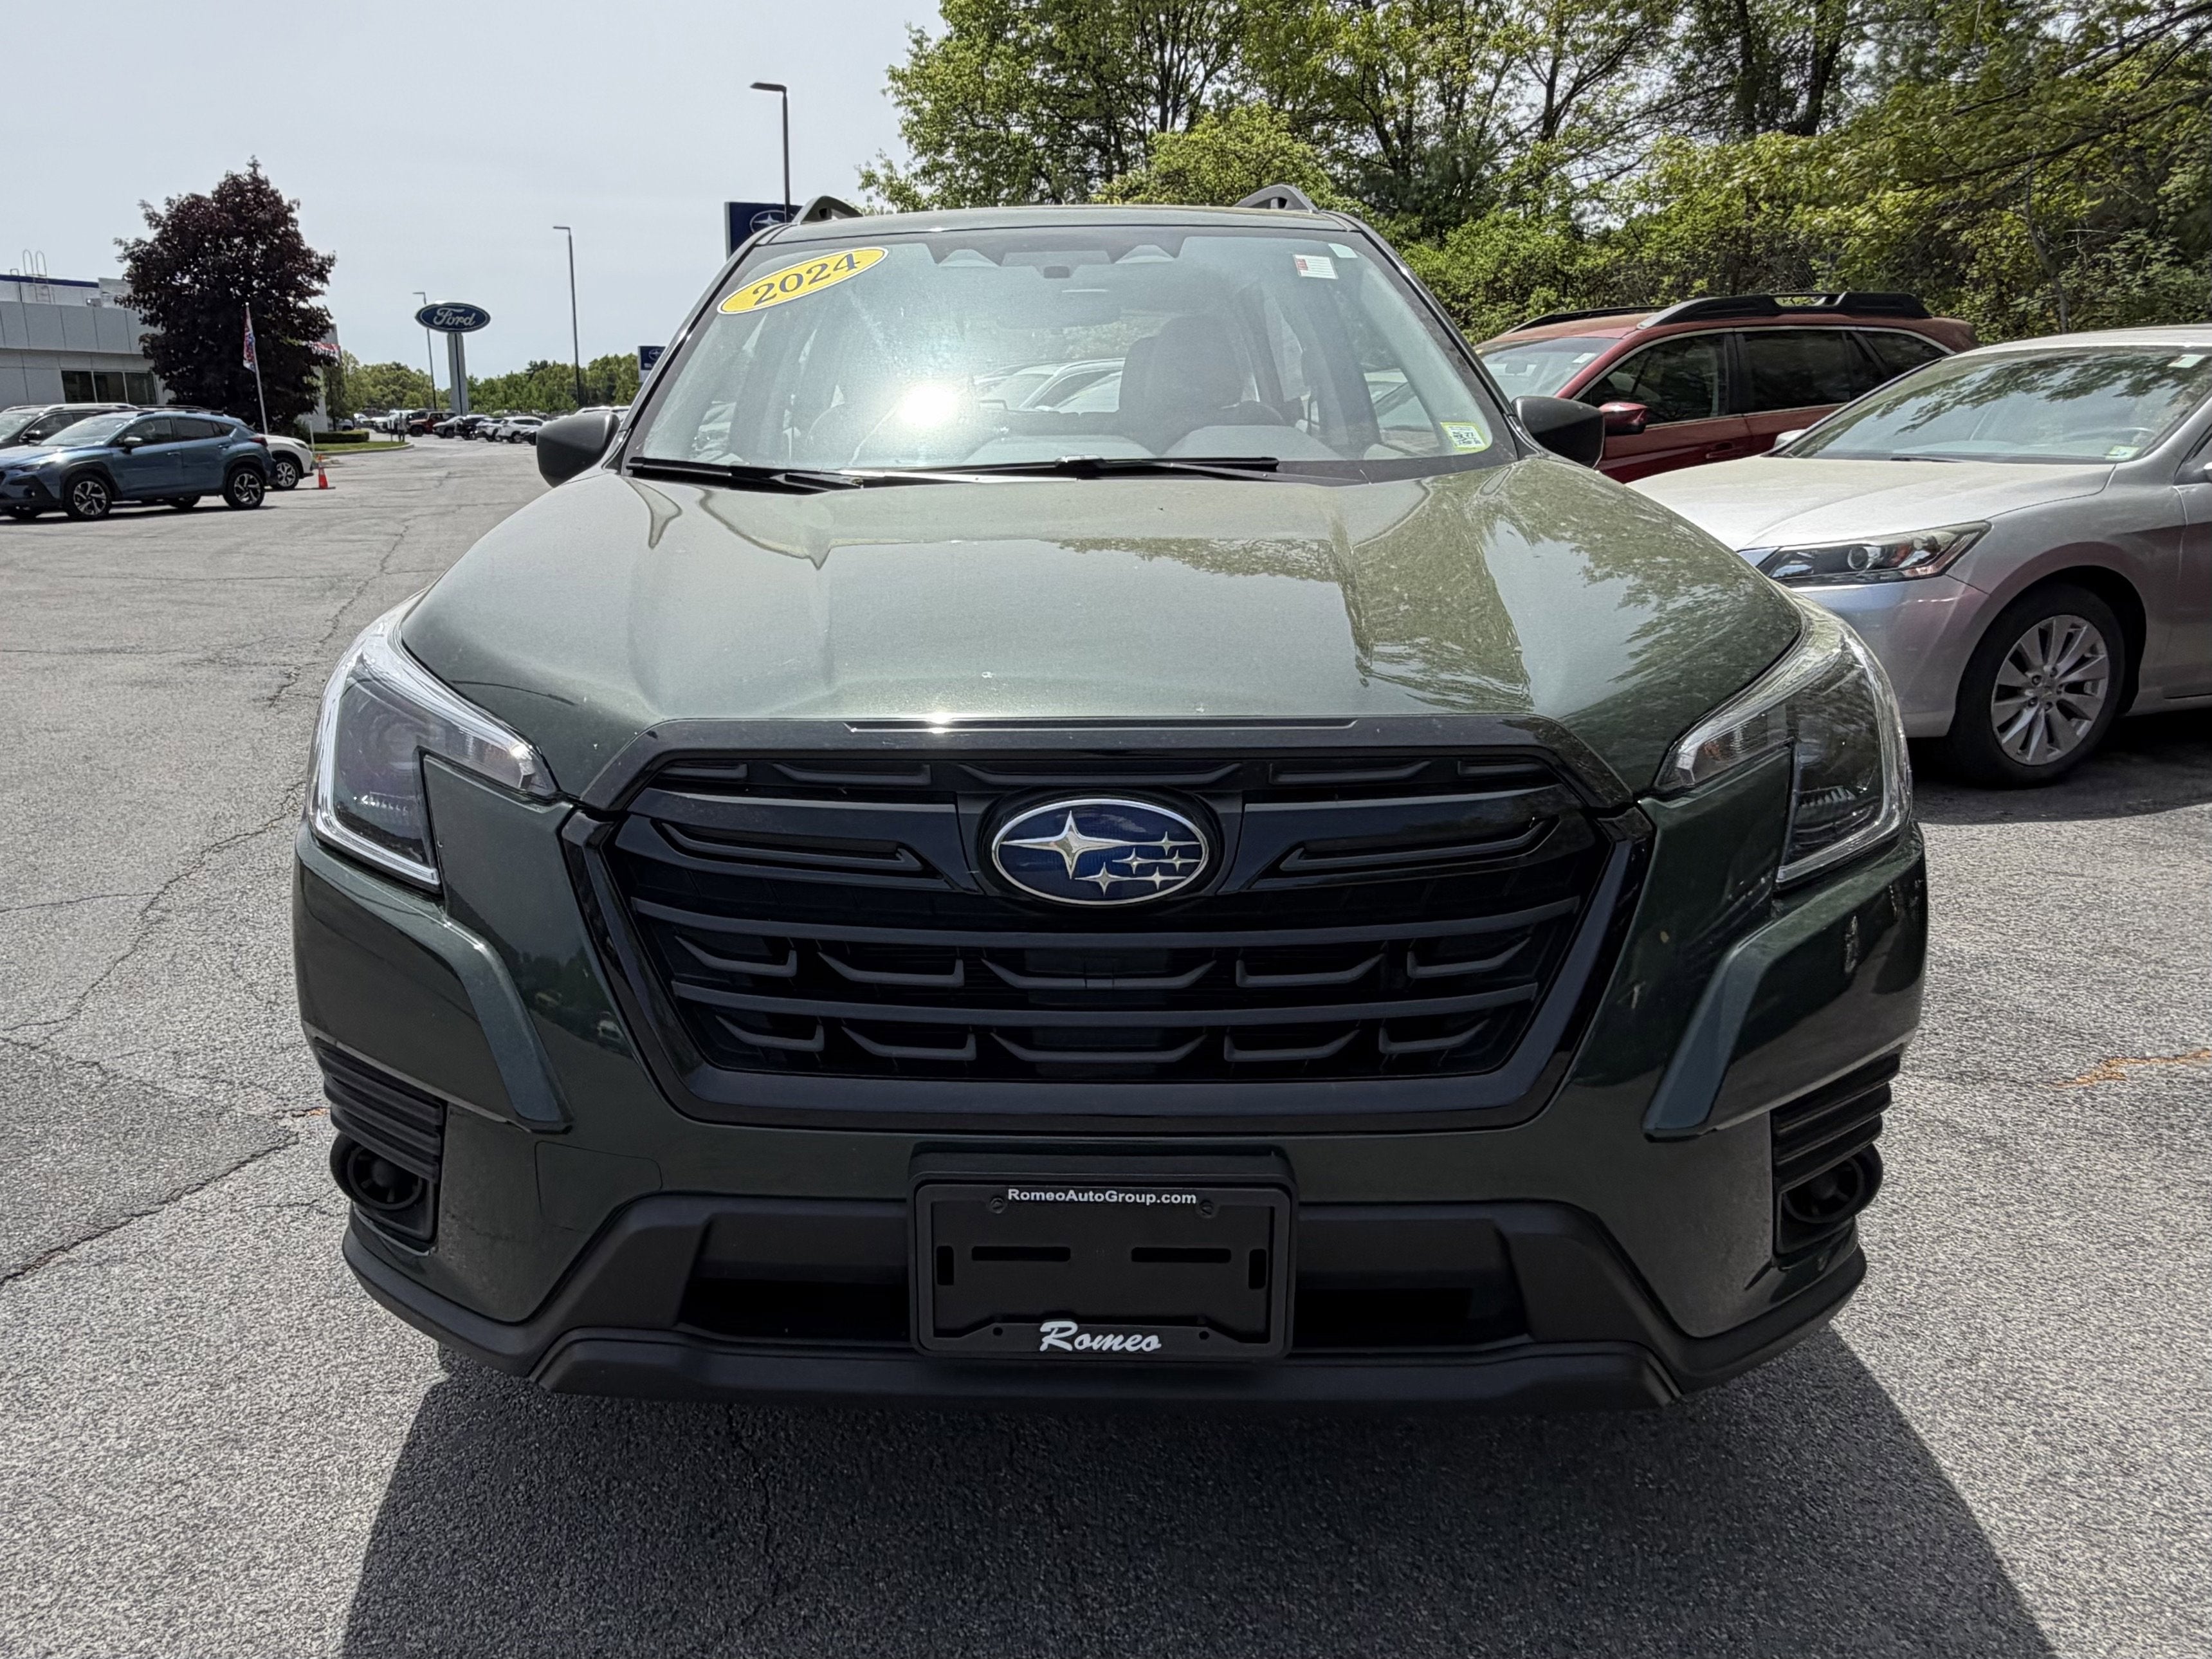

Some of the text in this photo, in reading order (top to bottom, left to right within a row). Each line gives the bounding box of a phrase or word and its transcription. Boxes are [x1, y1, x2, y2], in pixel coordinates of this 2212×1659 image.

[753, 253, 861, 306] 2024
[433, 307, 475, 325] Ford
[1008, 1189, 1196, 1206] RomeoAutoGroup.com
[1039, 1320, 1162, 1353] Romeo
